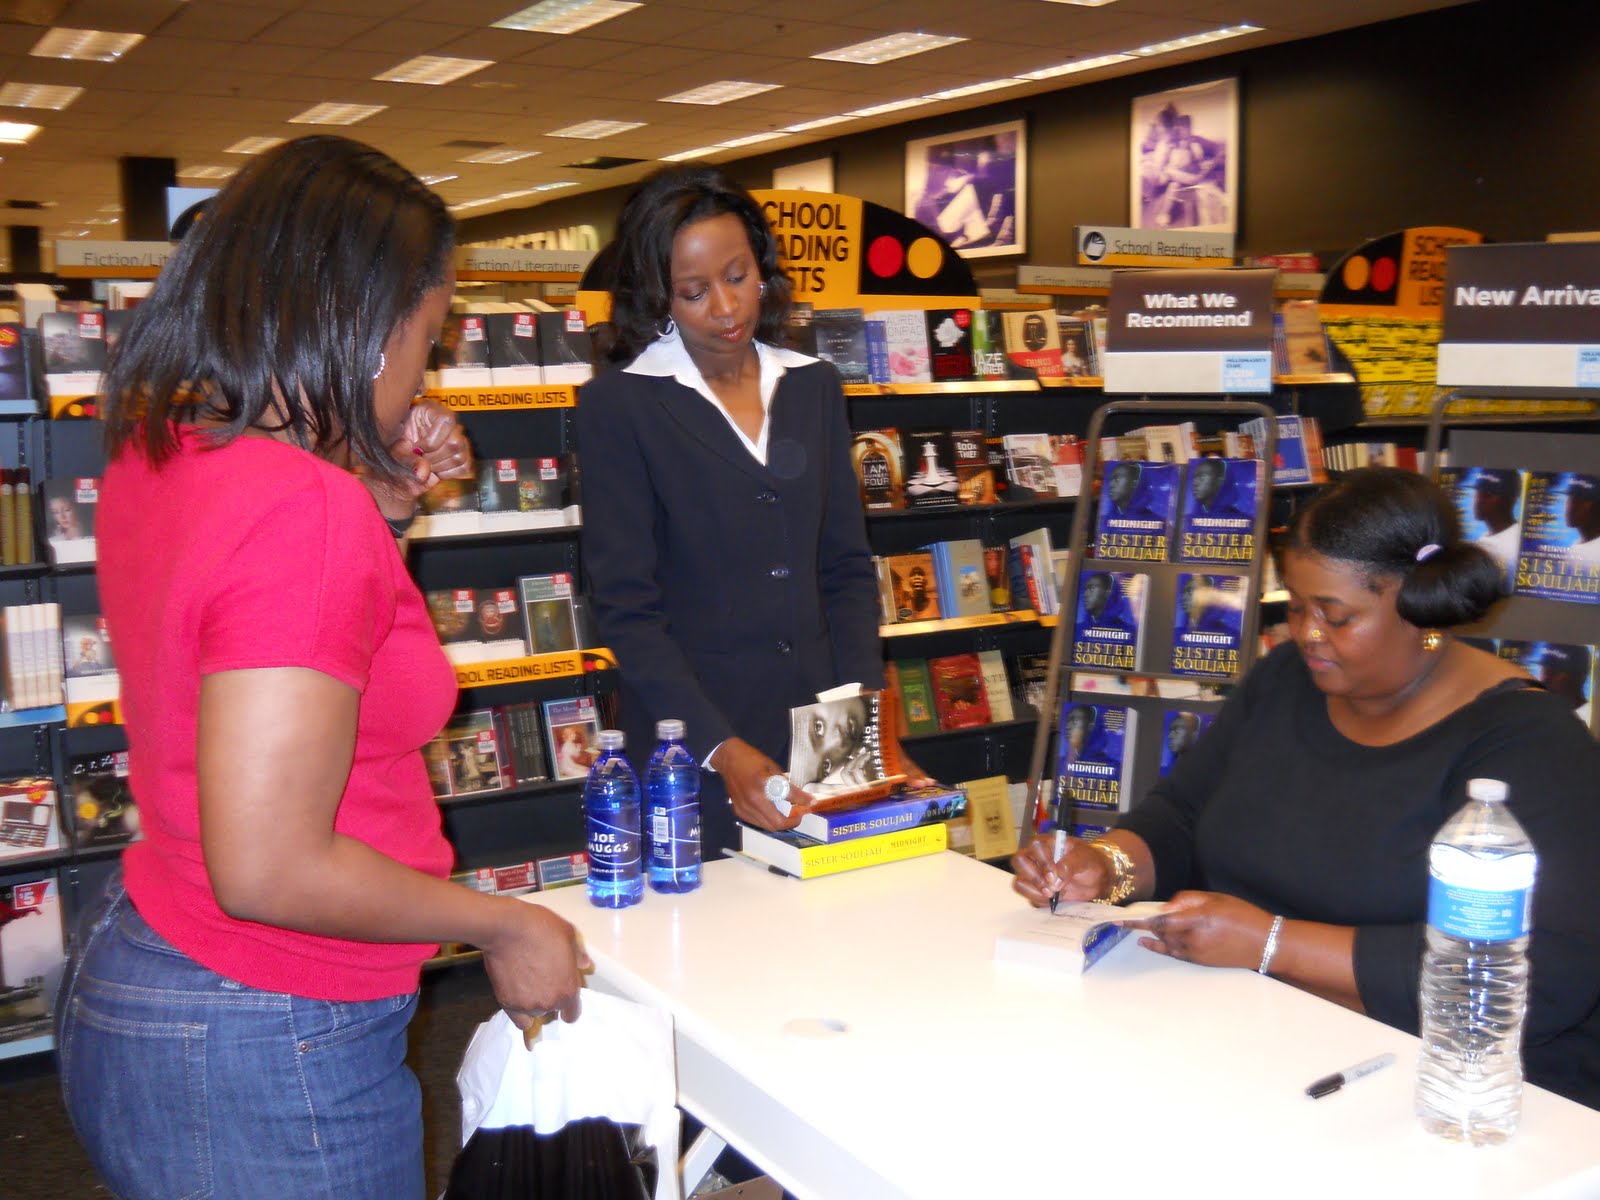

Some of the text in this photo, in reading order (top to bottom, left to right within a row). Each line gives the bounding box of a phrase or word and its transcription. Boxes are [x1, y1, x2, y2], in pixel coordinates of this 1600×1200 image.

[763, 200, 846, 230] CHOOL
[776, 234, 849, 262] ADING
[1114, 240, 1226, 260] School Reading List
[83, 251, 169, 267] Fiction/Lit
[785, 266, 826, 293] STS
[1143, 293, 1237, 309] What We
[1455, 284, 1600, 306] New Arriva
[887, 314, 923, 326] AUREN
[1126, 311, 1253, 328] Recommend
[887, 326, 923, 337] ONRAD
[479, 392, 534, 406] READING
[536, 391, 567, 404] LISTS
[869, 464, 888, 474] AM
[864, 477, 890, 486] FOUR
[1108, 519, 1163, 530] MIDNIGHT
[1192, 518, 1252, 528] MIDNIGHT
[1100, 533, 1167, 548] SISTER
[1184, 532, 1253, 547] SISTER
[1098, 546, 1167, 561] SOULJAH
[1183, 545, 1254, 560] SOULJAH
[1519, 557, 1600, 577] SISTER
[1517, 572, 1600, 593] SOULJAH
[1083, 629, 1131, 640] MIDNIGHT
[1183, 633, 1233, 645] MIDNIGHT
[1076, 642, 1135, 656] SISTER
[1175, 646, 1237, 661] SISTER
[1074, 653, 1135, 668] SOULJAH
[1173, 658, 1238, 673] SOULJAH
[457, 659, 575, 683] OOL READING LISTS
[865, 726, 871, 744] NO
[872, 697, 886, 780] DISRESPECT
[1067, 763, 1115, 776] MIDNIGHT
[1058, 775, 1119, 792] SISTER
[833, 823, 867, 836] SISTER
[869, 813, 913, 827] SOULJAH
[594, 832, 616, 843] JOE
[588, 842, 629, 853] MUGGS
[805, 836, 927, 868] SISTER SOULJAH MIDNIGHT
